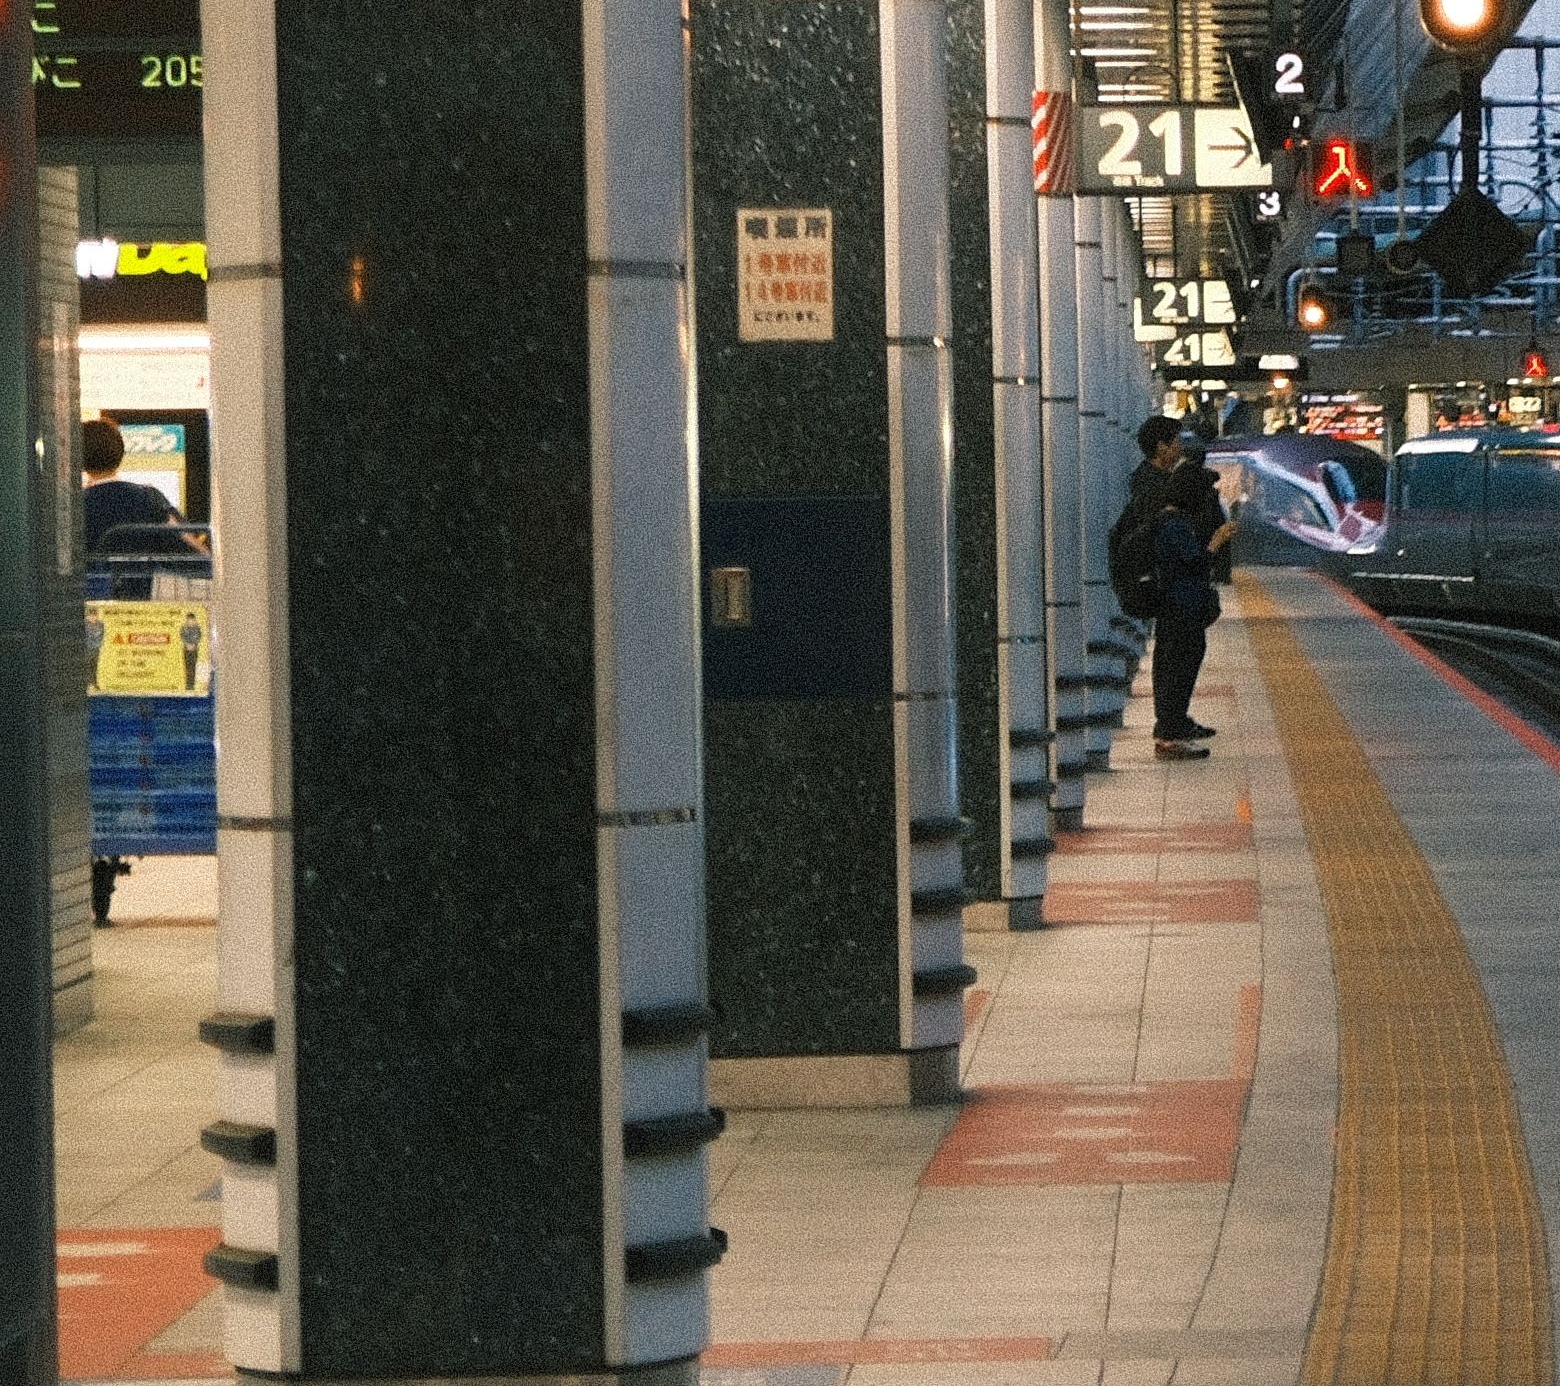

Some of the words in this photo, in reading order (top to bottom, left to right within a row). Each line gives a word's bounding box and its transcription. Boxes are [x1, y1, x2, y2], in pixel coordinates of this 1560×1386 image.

[1274, 53, 1305, 94] 2
[1098, 110, 1182, 175] 21
[1258, 191, 1281, 217] 3
[1152, 280, 1199, 319] 21
